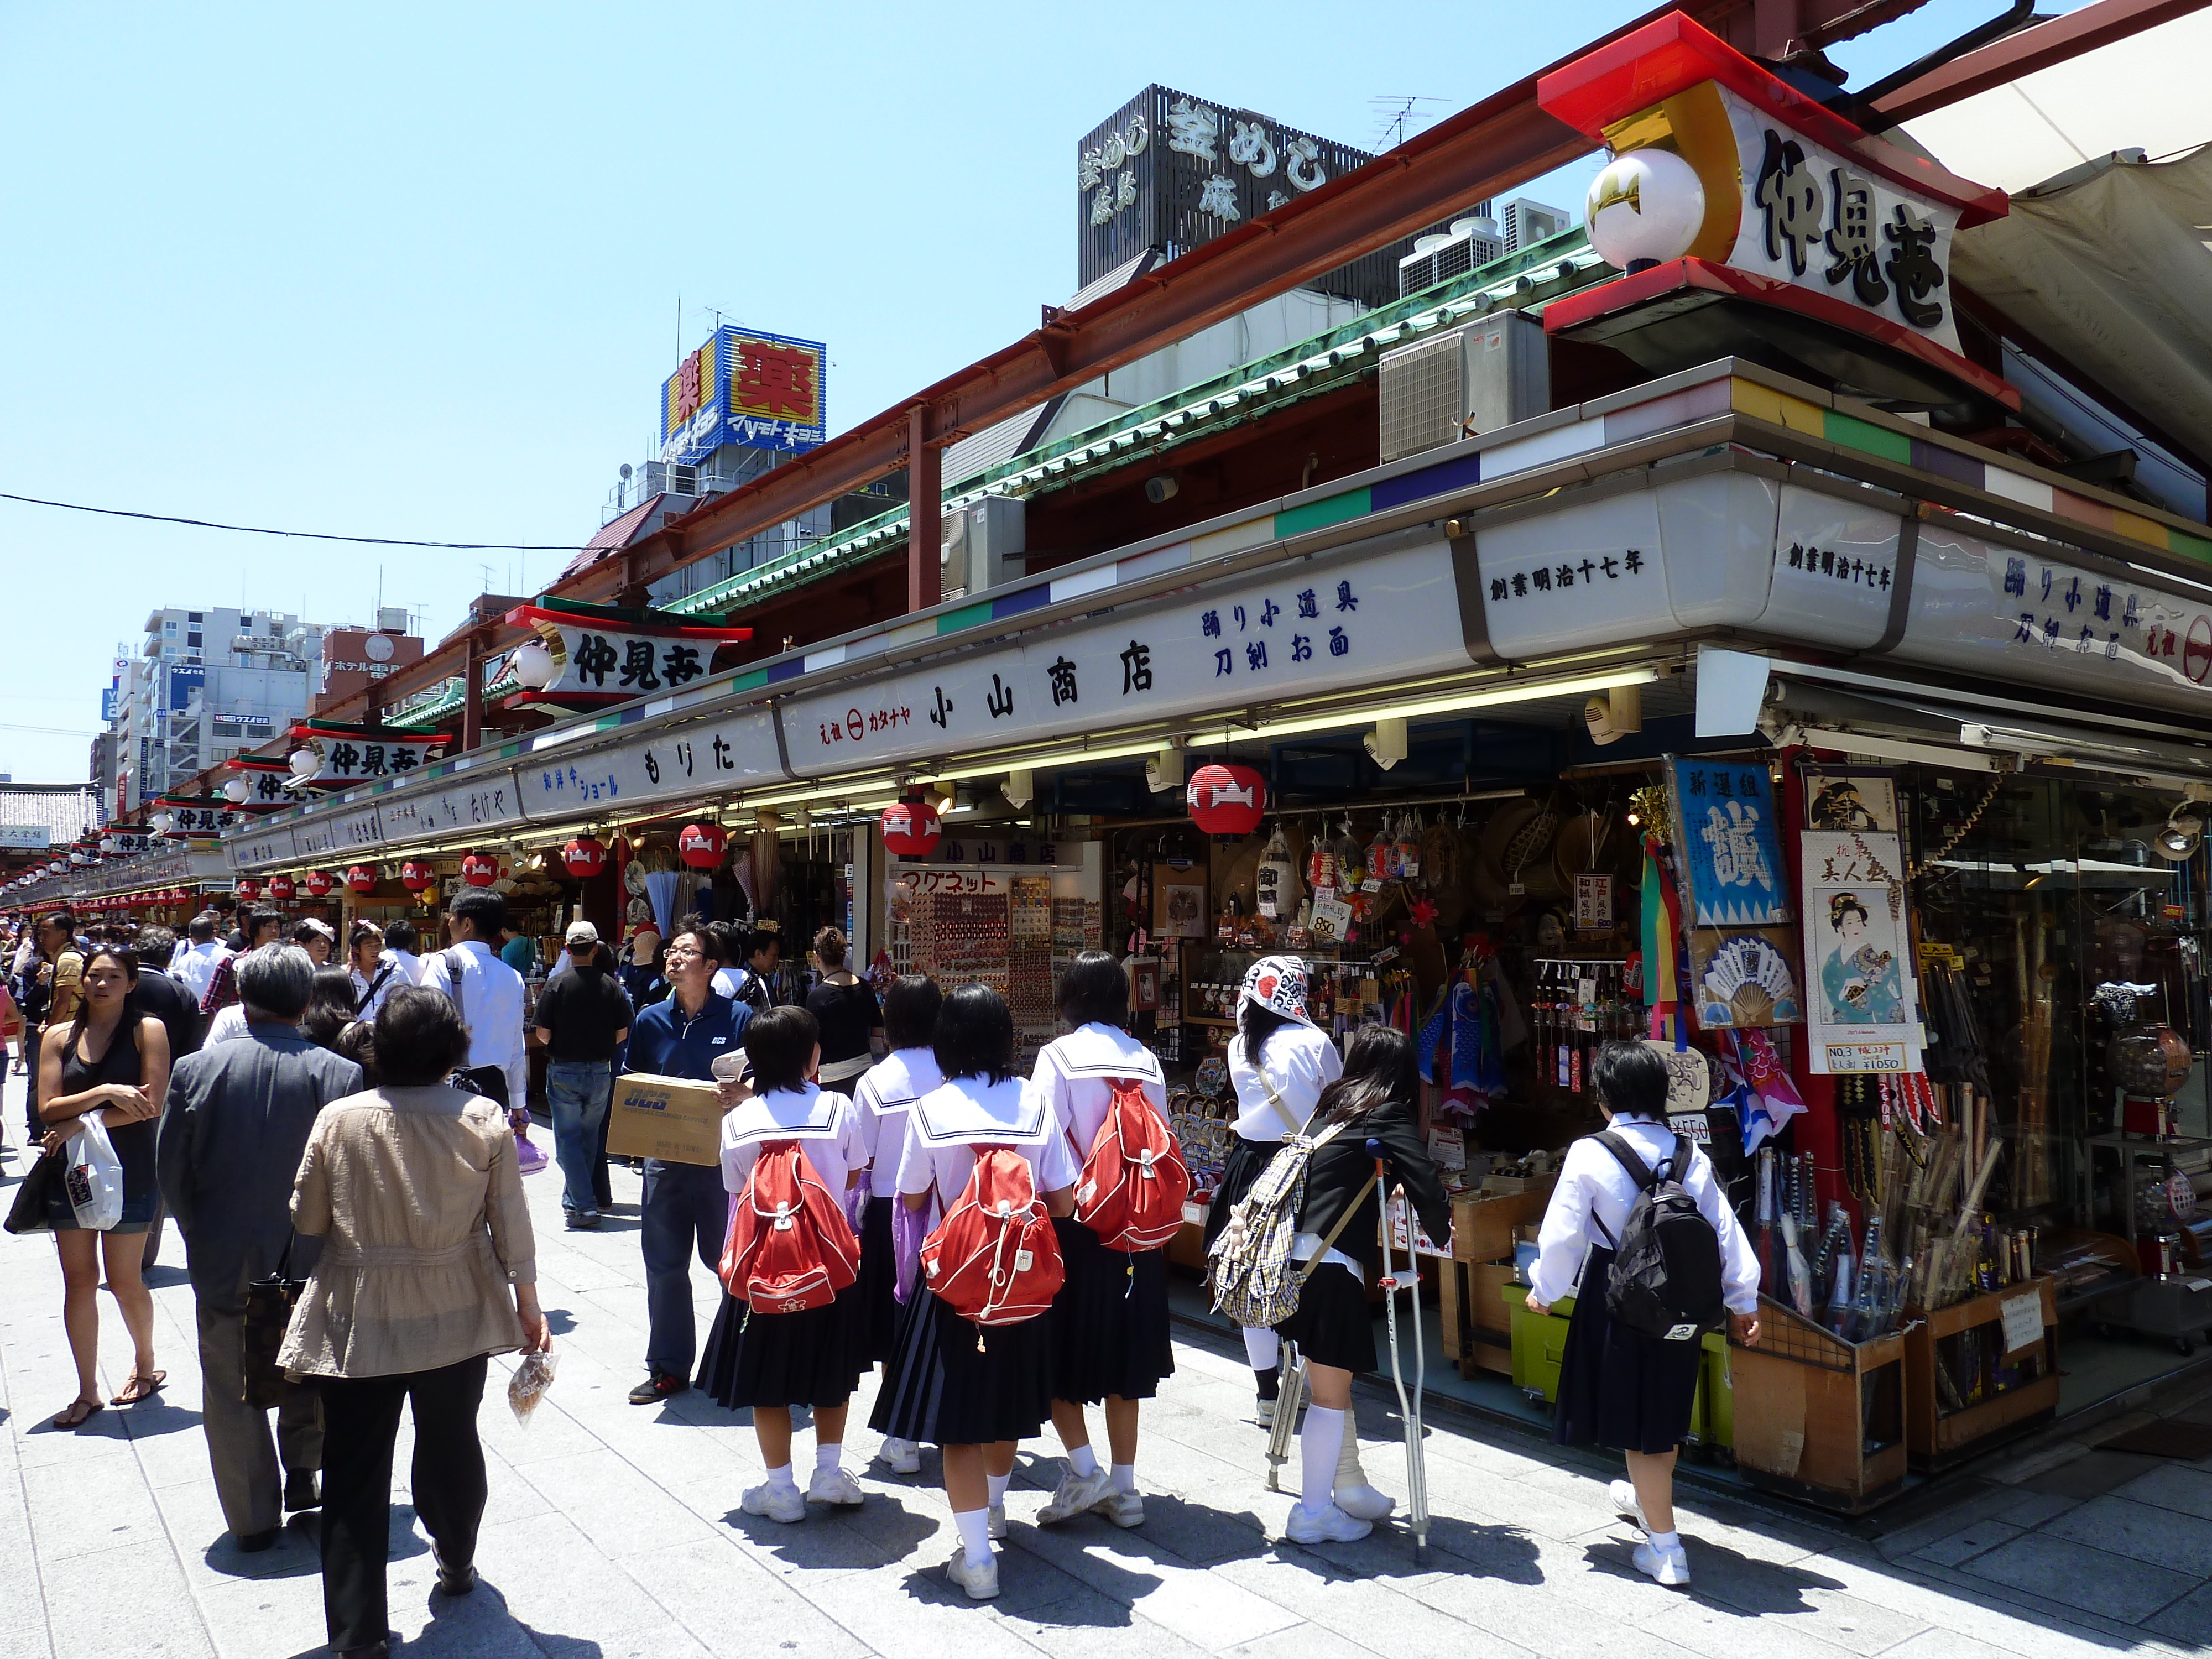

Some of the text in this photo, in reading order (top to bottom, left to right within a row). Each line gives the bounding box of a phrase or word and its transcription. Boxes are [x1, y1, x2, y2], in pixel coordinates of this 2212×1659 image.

[677, 349, 701, 422] 薬
[738, 342, 813, 416] 薬
[727, 415, 824, 442] マツモトキヨシ
[1490, 550, 1644, 601] 創業明治十七年
[1790, 542, 1891, 592] 創業明治十七年
[2004, 557, 2139, 626] 踊り小道具
[1201, 580, 1358, 639] 踊り小道具
[820, 640, 1152, 746] 元祖 カタナヤ 小山商店
[645, 734, 734, 784] もりた
[1689, 769, 1760, 797] 新選組
[471, 789, 505, 823] たけや
[580, 774, 618, 801] ショール
[946, 841, 1055, 863] 小山商店
[624, 1088, 671, 1110] OCS
